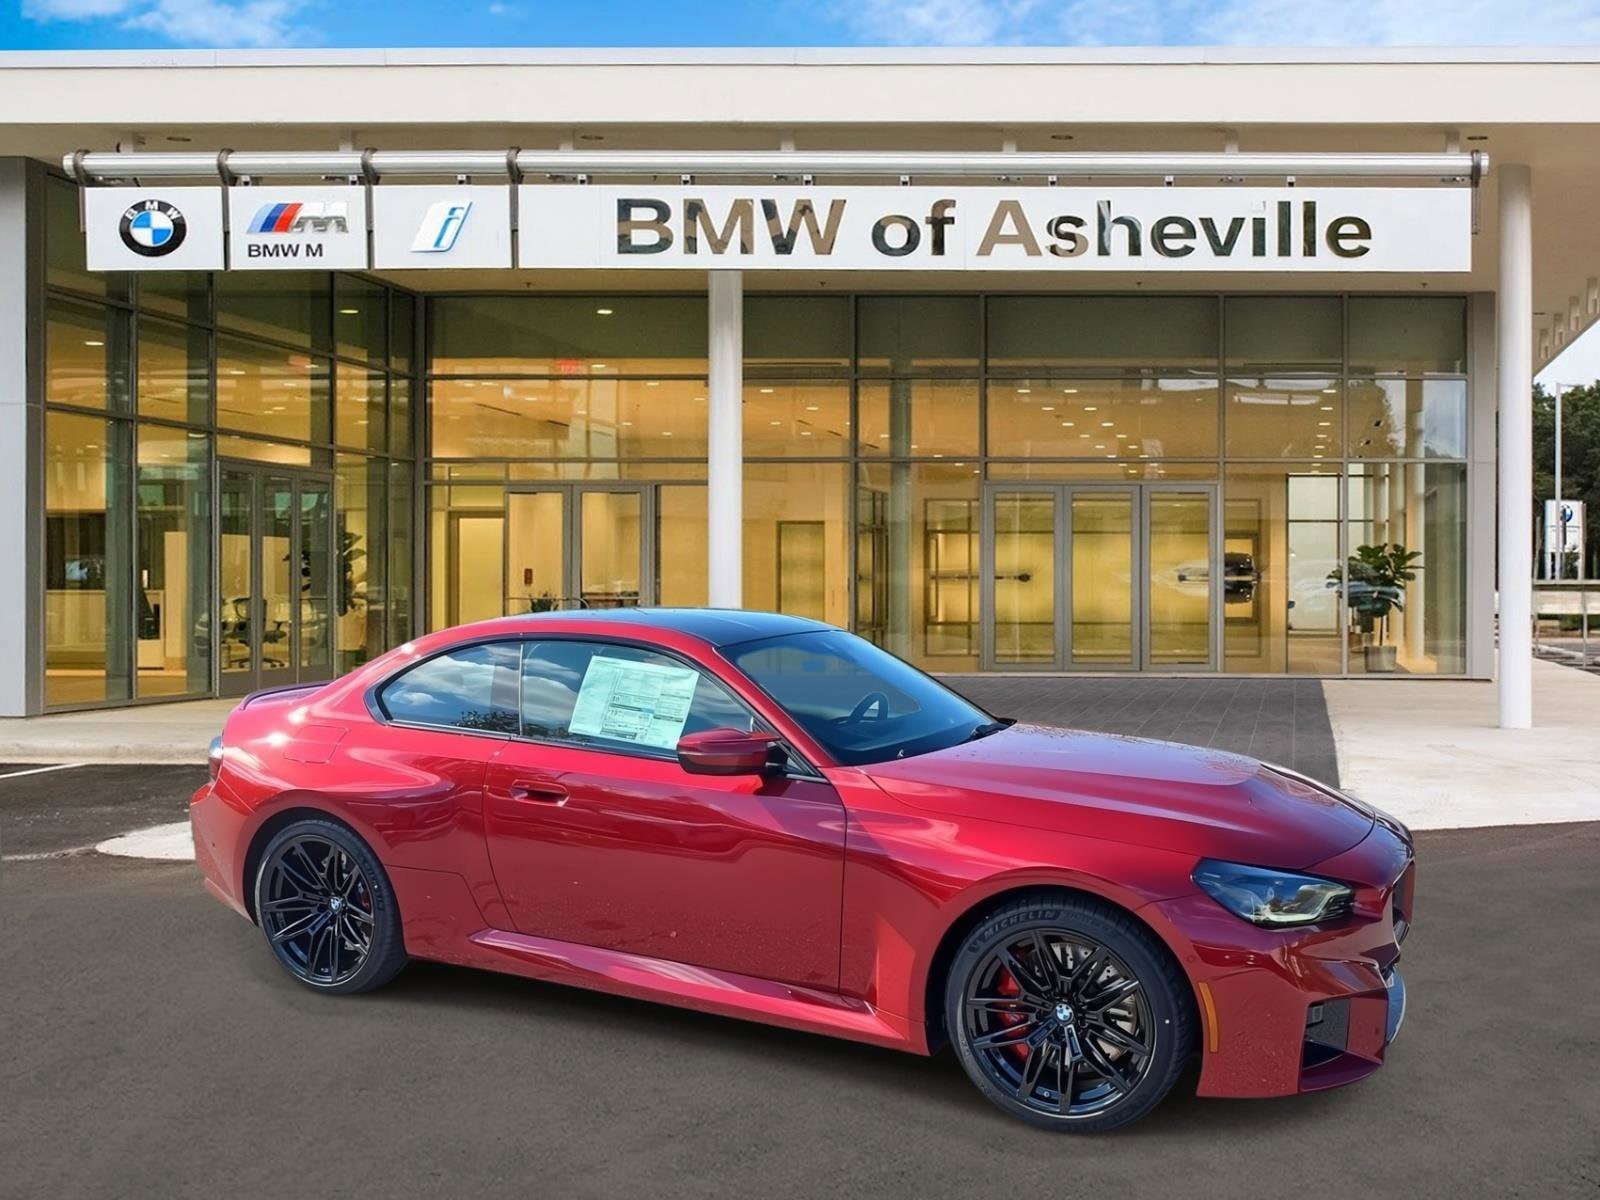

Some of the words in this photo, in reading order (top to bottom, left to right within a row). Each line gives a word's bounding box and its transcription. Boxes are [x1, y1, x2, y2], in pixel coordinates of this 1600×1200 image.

[125, 200, 181, 220] BMW
[616, 198, 847, 255] BMW
[871, 199, 957, 257] of
[975, 199, 1372, 258] Asheville
[247, 243, 300, 258] BMW
[305, 243, 323, 257] M
[983, 910, 1056, 939] MICHELIN
